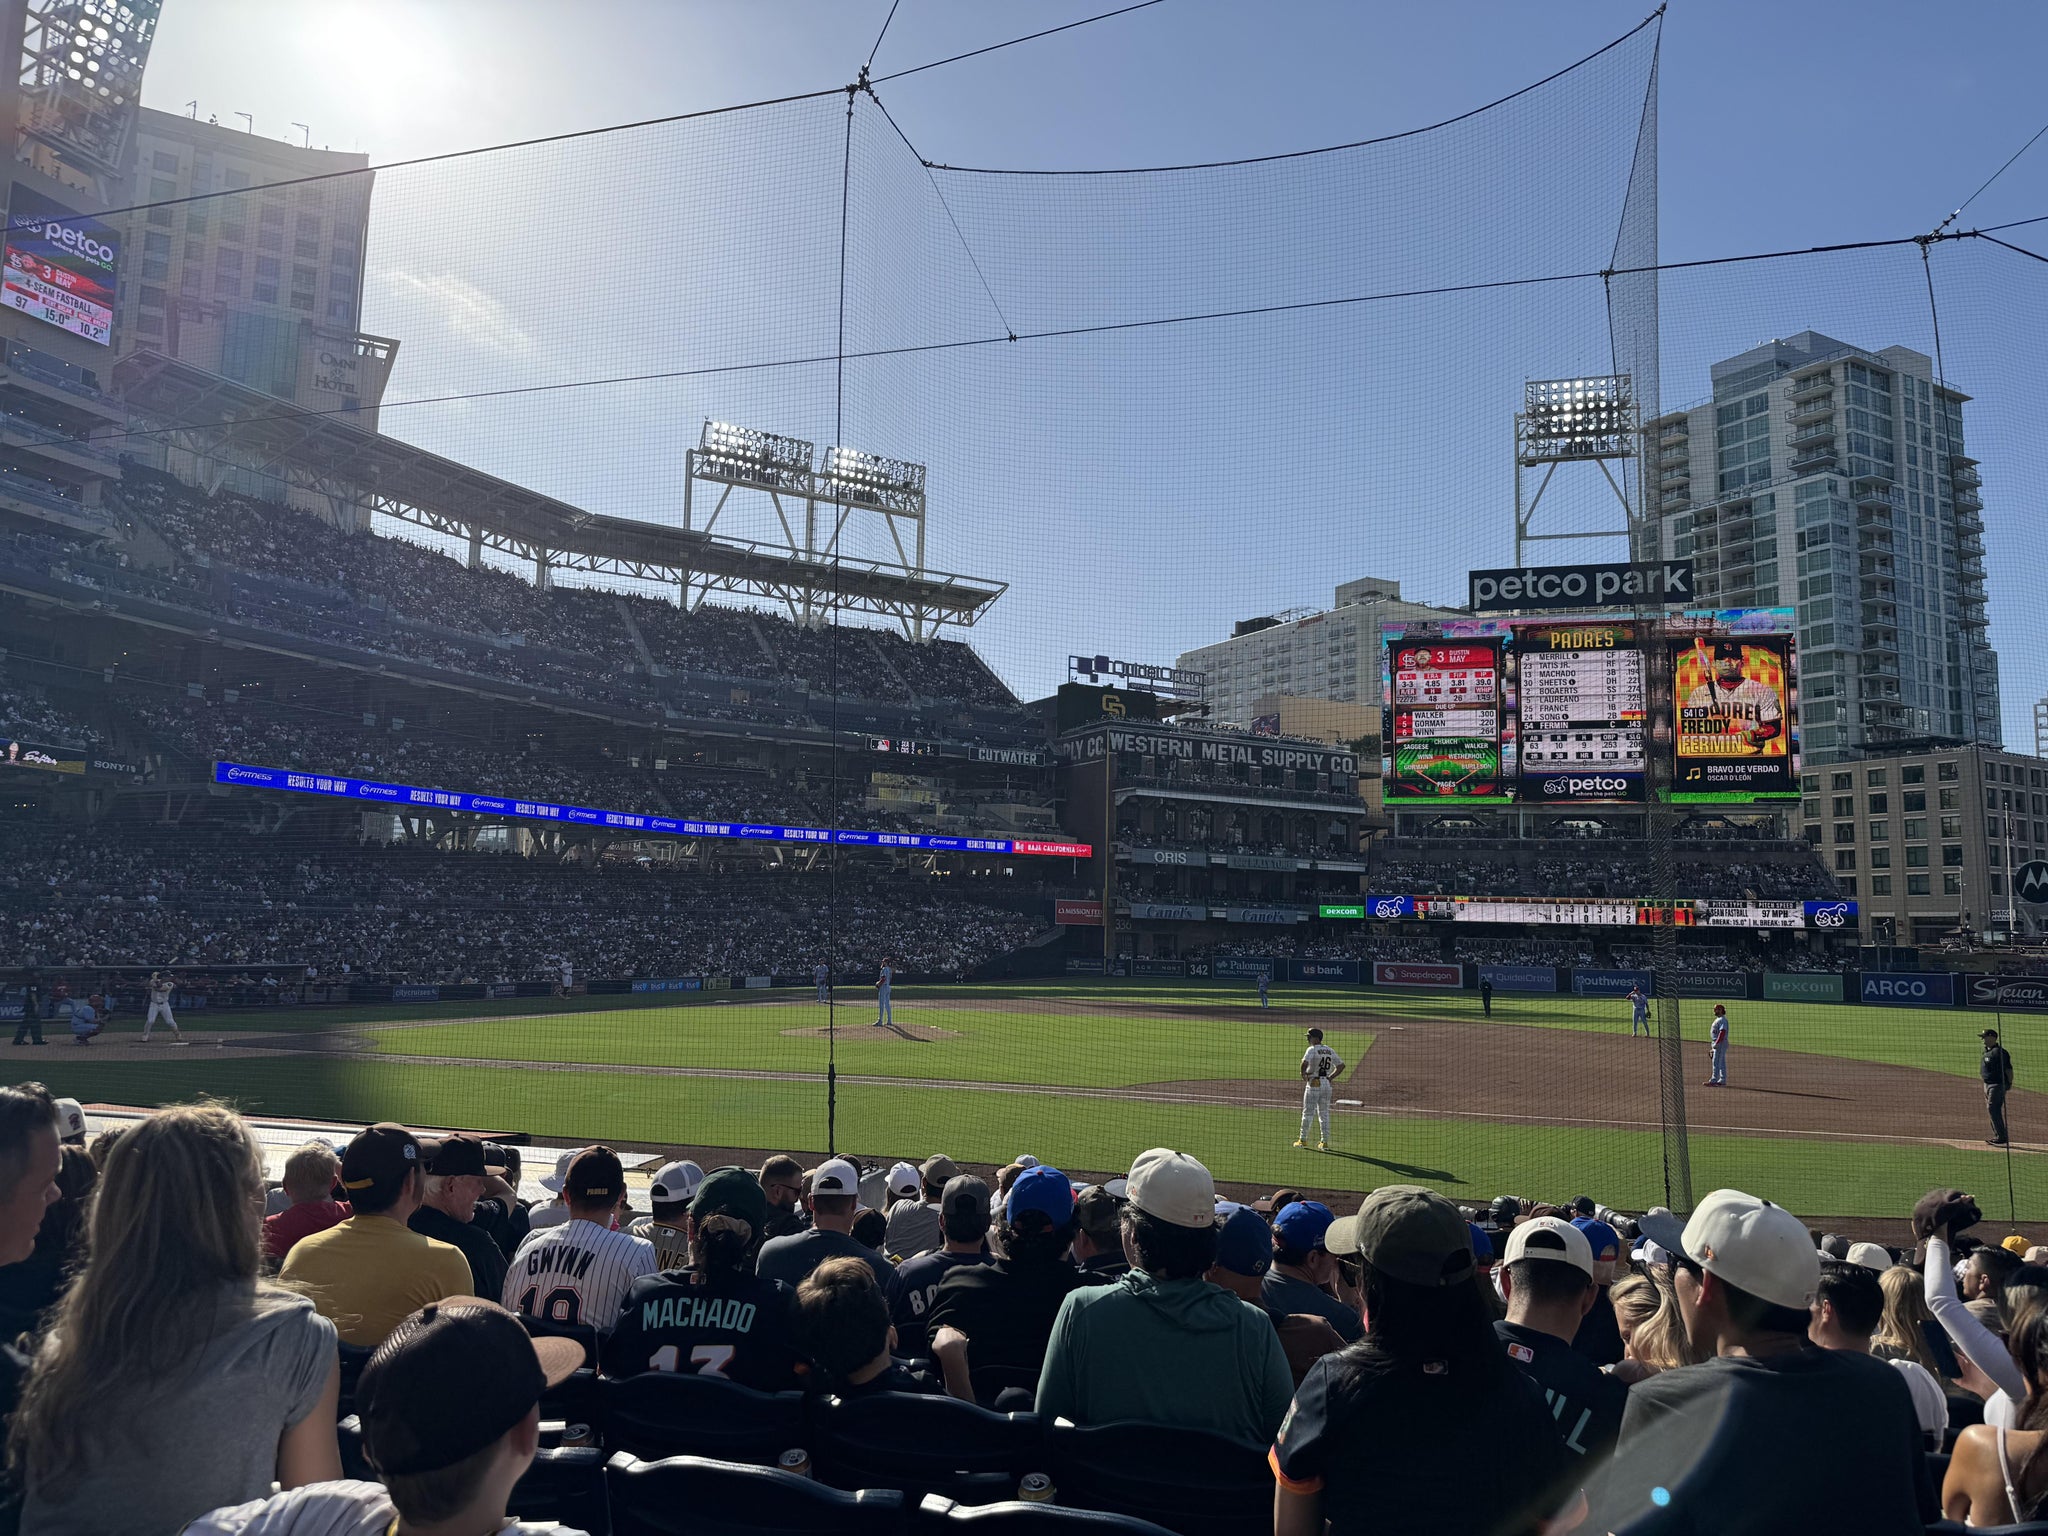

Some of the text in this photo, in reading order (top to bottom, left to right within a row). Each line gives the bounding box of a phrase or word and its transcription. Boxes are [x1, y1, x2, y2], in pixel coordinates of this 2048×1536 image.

[45, 223, 113, 262] petco
[43, 266, 51, 279] 3
[55, 276, 73, 289] MAY
[15, 296, 28, 309] 97
[25, 280, 92, 314] 4-SEAM FASTBALL
[320, 352, 356, 371] OMNI
[315, 375, 357, 394] HOTEL
[1474, 565, 1688, 609] petco park
[1551, 630, 1614, 649] PADRES
[1437, 651, 1444, 663] 3
[1449, 655, 1466, 663] MAY
[1606, 651, 1616, 659] CF
[1113, 661, 1201, 685] QuidelOrtho
[1606, 677, 1617, 685] DH
[1539, 687, 1578, 695] BOGAERTS
[1684, 708, 1704, 717] 54 C
[1681, 719, 1730, 734] FREDDY
[1681, 734, 1743, 754] FERMIN
[978, 748, 1037, 765] CUTWATER
[1110, 733, 1357, 774] WESTERN METAL SUPPLY CO.
[94, 760, 124, 772] SONY
[1707, 765, 1779, 773] BRAVO DE VERDAD
[288, 774, 348, 793] RESULTS YOUR WAY
[1569, 775, 1627, 794] petco
[410, 790, 461, 806] RESULTS YOUR WAY
[784, 829, 804, 839] RESULTS
[805, 830, 817, 839] YOUR
[1028, 843, 1041, 851] BAJA
[1043, 844, 1075, 853] CALIFORNIA
[1154, 851, 1187, 864] ORIS
[1145, 905, 1193, 919] Canel's
[1241, 908, 1285, 923] Canel's
[1771, 910, 1788, 918] MPH
[1115, 918, 1132, 930] 336
[1190, 964, 1208, 976] 342
[1230, 960, 1270, 970] Palomar
[1303, 965, 1343, 976] us bank
[1401, 969, 1452, 981] Snapdragon
[1496, 973, 1552, 984] QuidelOrtho
[1675, 976, 1743, 986] YMBIOTIKA
[1864, 980, 1926, 997] ARCO
[1319, 1056, 1331, 1070] 46
[527, 1246, 595, 1280] GWYNN
[642, 1297, 756, 1333] MACHADO
